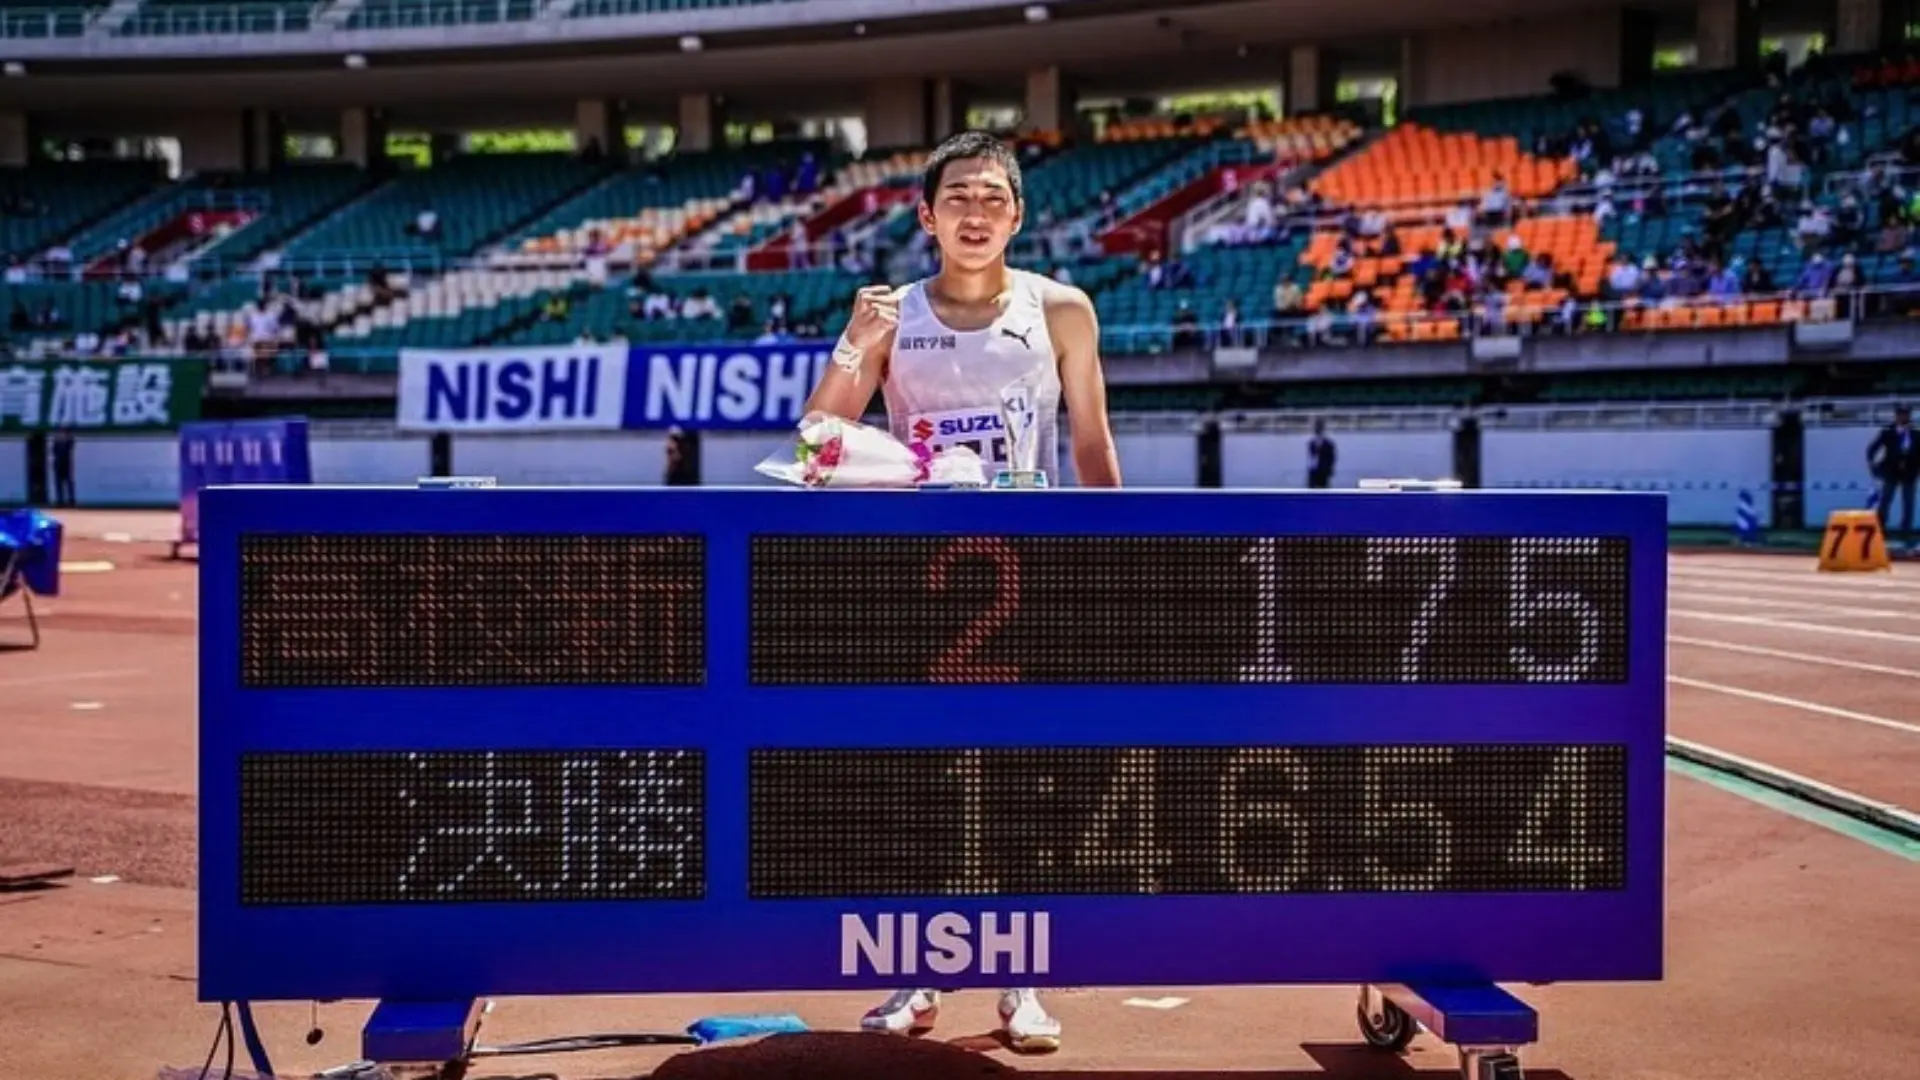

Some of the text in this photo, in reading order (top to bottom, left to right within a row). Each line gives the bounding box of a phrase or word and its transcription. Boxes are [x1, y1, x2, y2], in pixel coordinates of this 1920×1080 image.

[0, 363, 173, 426] 育施設
[426, 357, 601, 422] NISHI
[939, 414, 1005, 435] SUZU
[1831, 524, 1877, 560] 77
[928, 537, 1600, 683] 2 175
[399, 750, 693, 891] 決勝
[840, 912, 1050, 976] NISHI
